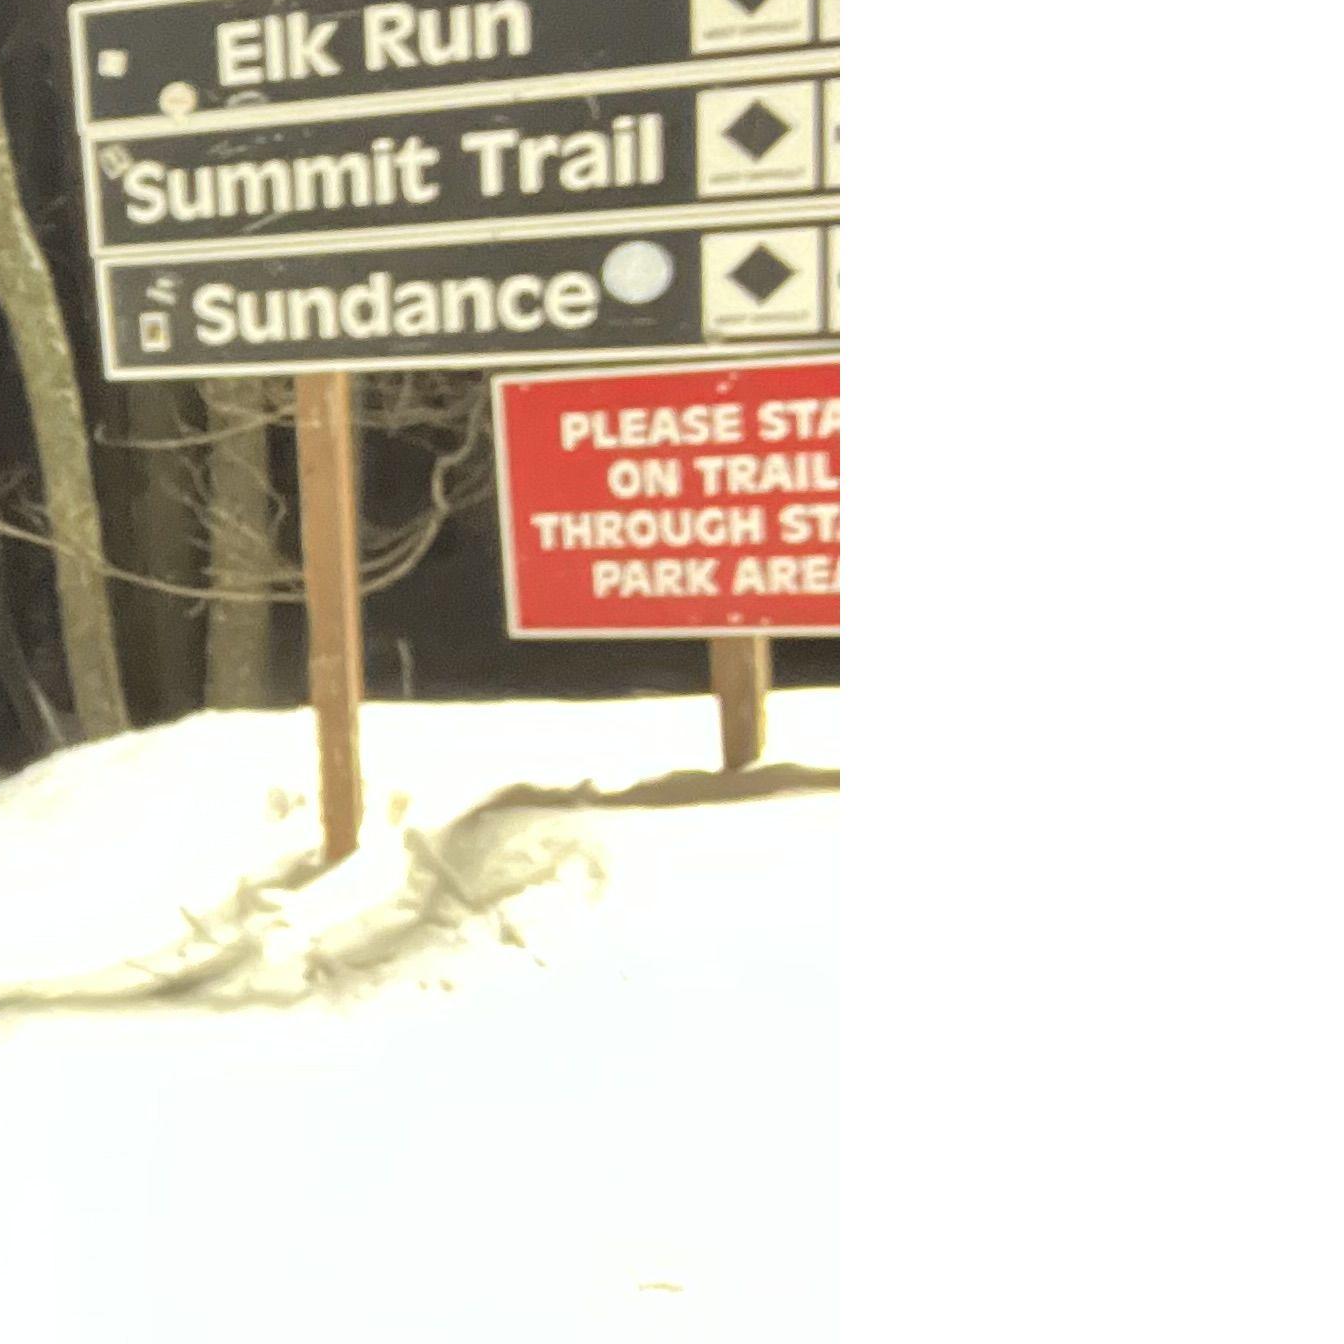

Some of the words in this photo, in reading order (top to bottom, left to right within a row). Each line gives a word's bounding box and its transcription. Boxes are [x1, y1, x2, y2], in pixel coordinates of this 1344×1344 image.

[216, 10, 341, 87] Elk
[123, 136, 441, 225] Summit
[461, 112, 665, 197] Trail
[192, 270, 600, 346] Sundance
[560, 402, 743, 452] PLEASE
[607, 458, 681, 500] ON
[693, 451, 840, 497] TRAIL
[529, 505, 766, 551] THROUGH
[777, 502, 840, 545] ST
[591, 557, 719, 599] PARK
